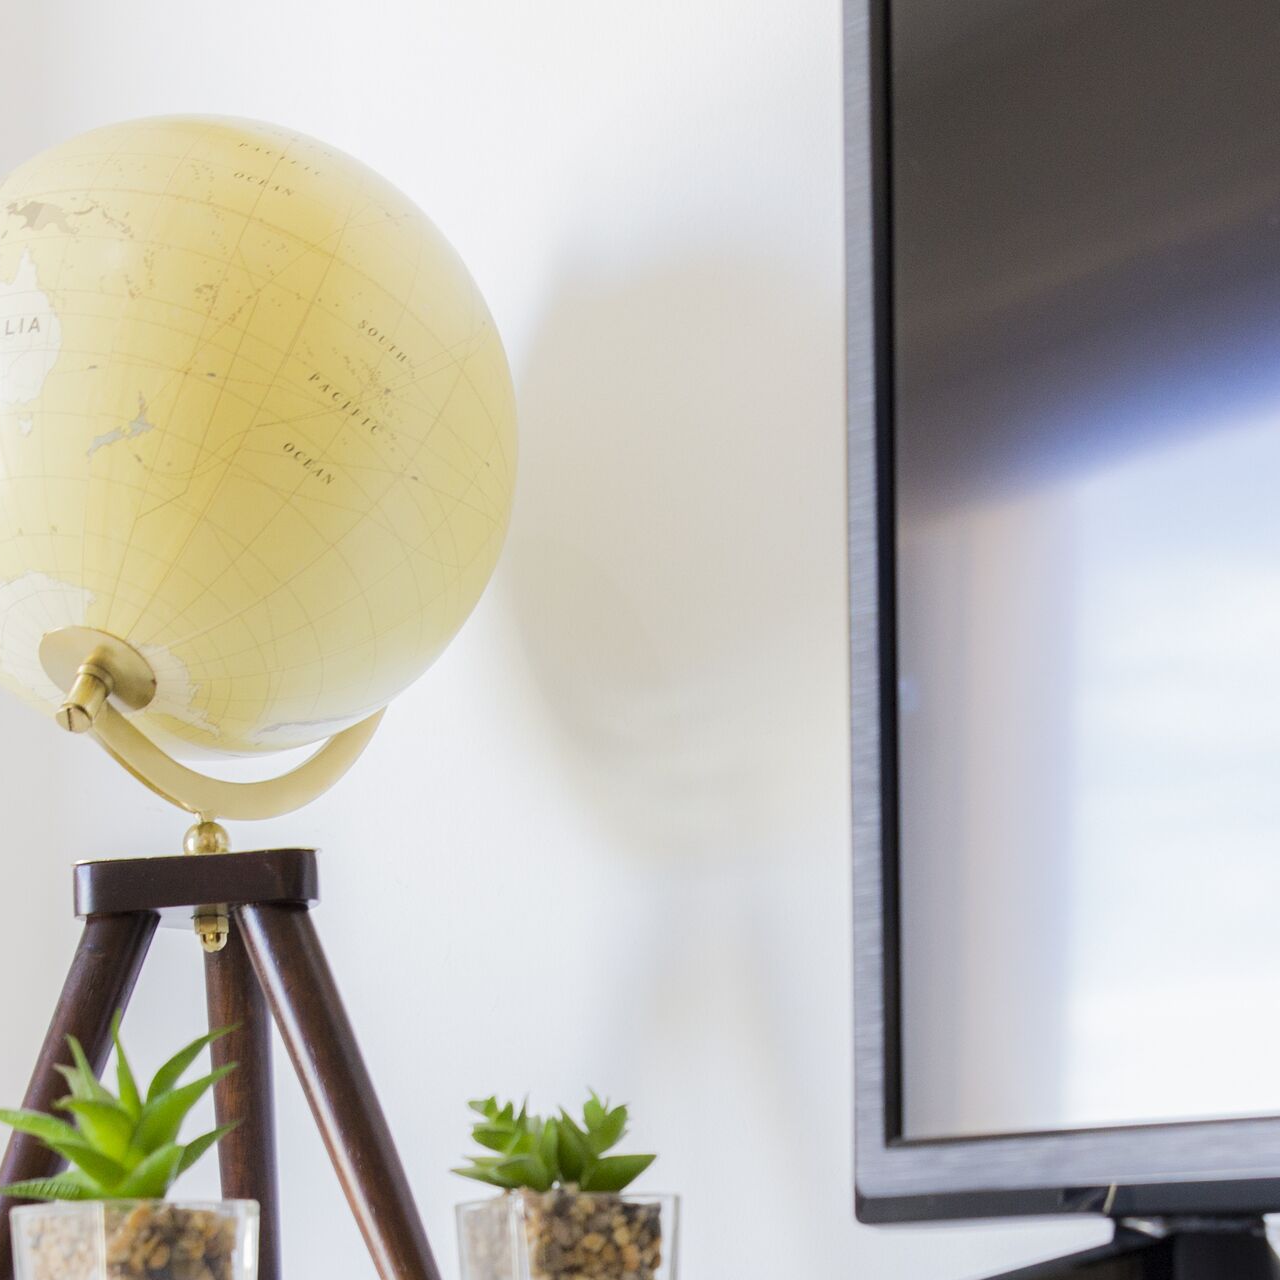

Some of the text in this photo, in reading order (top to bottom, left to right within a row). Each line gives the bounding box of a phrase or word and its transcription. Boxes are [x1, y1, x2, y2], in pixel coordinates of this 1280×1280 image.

[357, 319, 408, 362] SOUTH
[308, 371, 381, 435] PACIFIC
[282, 441, 336, 486] OCEAN
